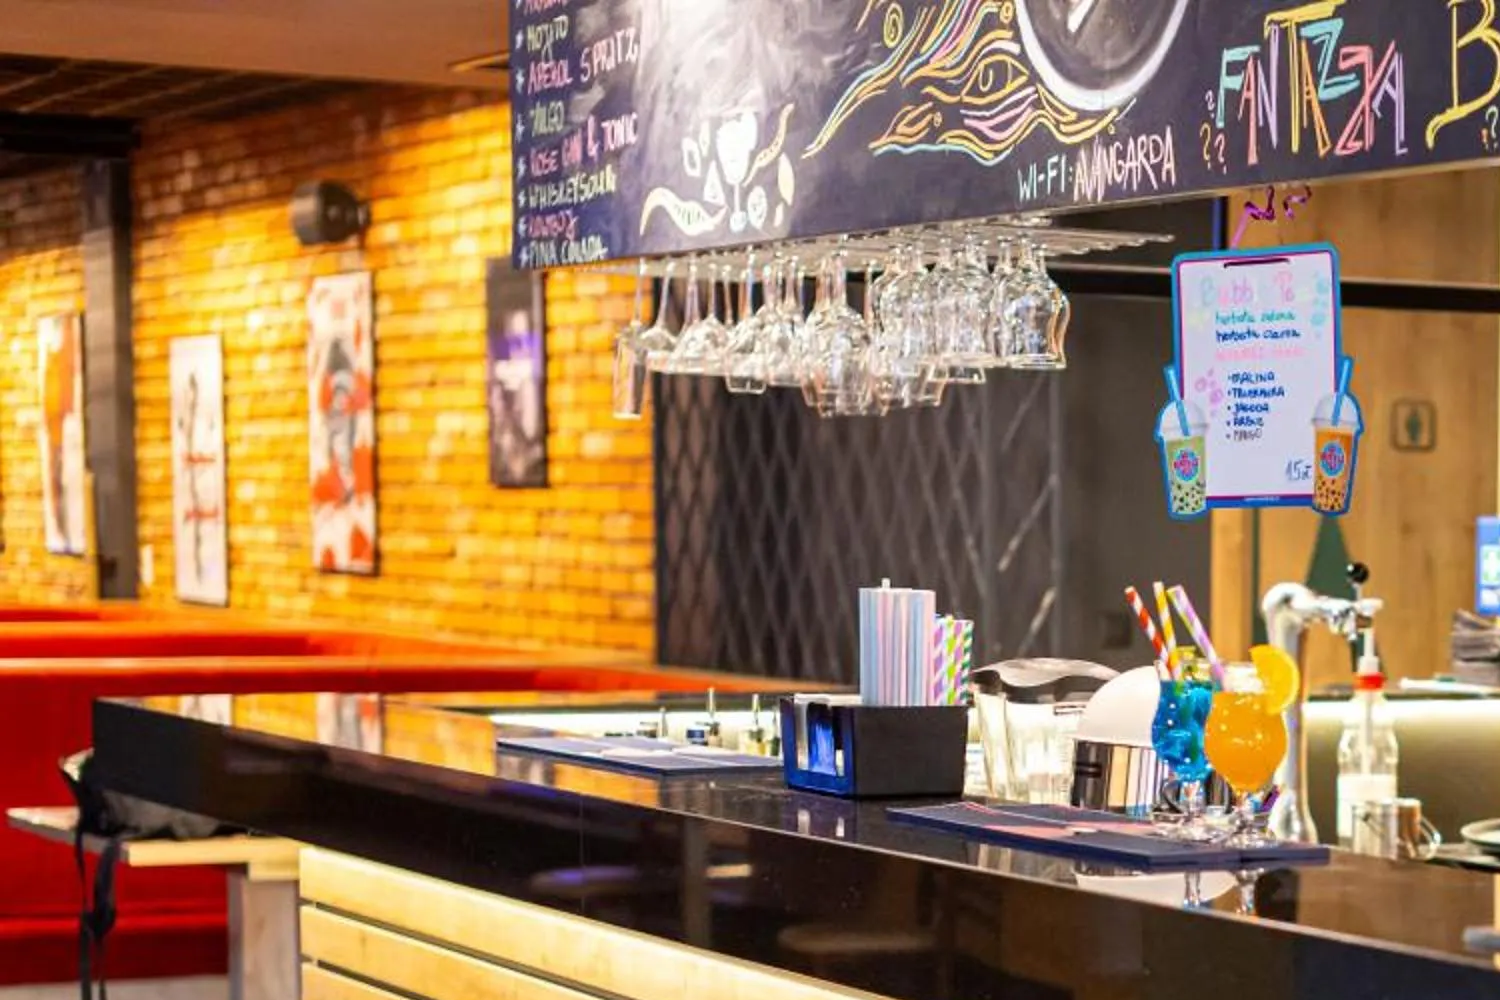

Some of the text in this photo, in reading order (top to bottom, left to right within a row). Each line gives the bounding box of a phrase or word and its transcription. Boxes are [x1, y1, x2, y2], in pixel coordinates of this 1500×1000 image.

[527, 26, 639, 95] APEROL SPRITZ
[1231, 371, 1276, 384] MALINA
